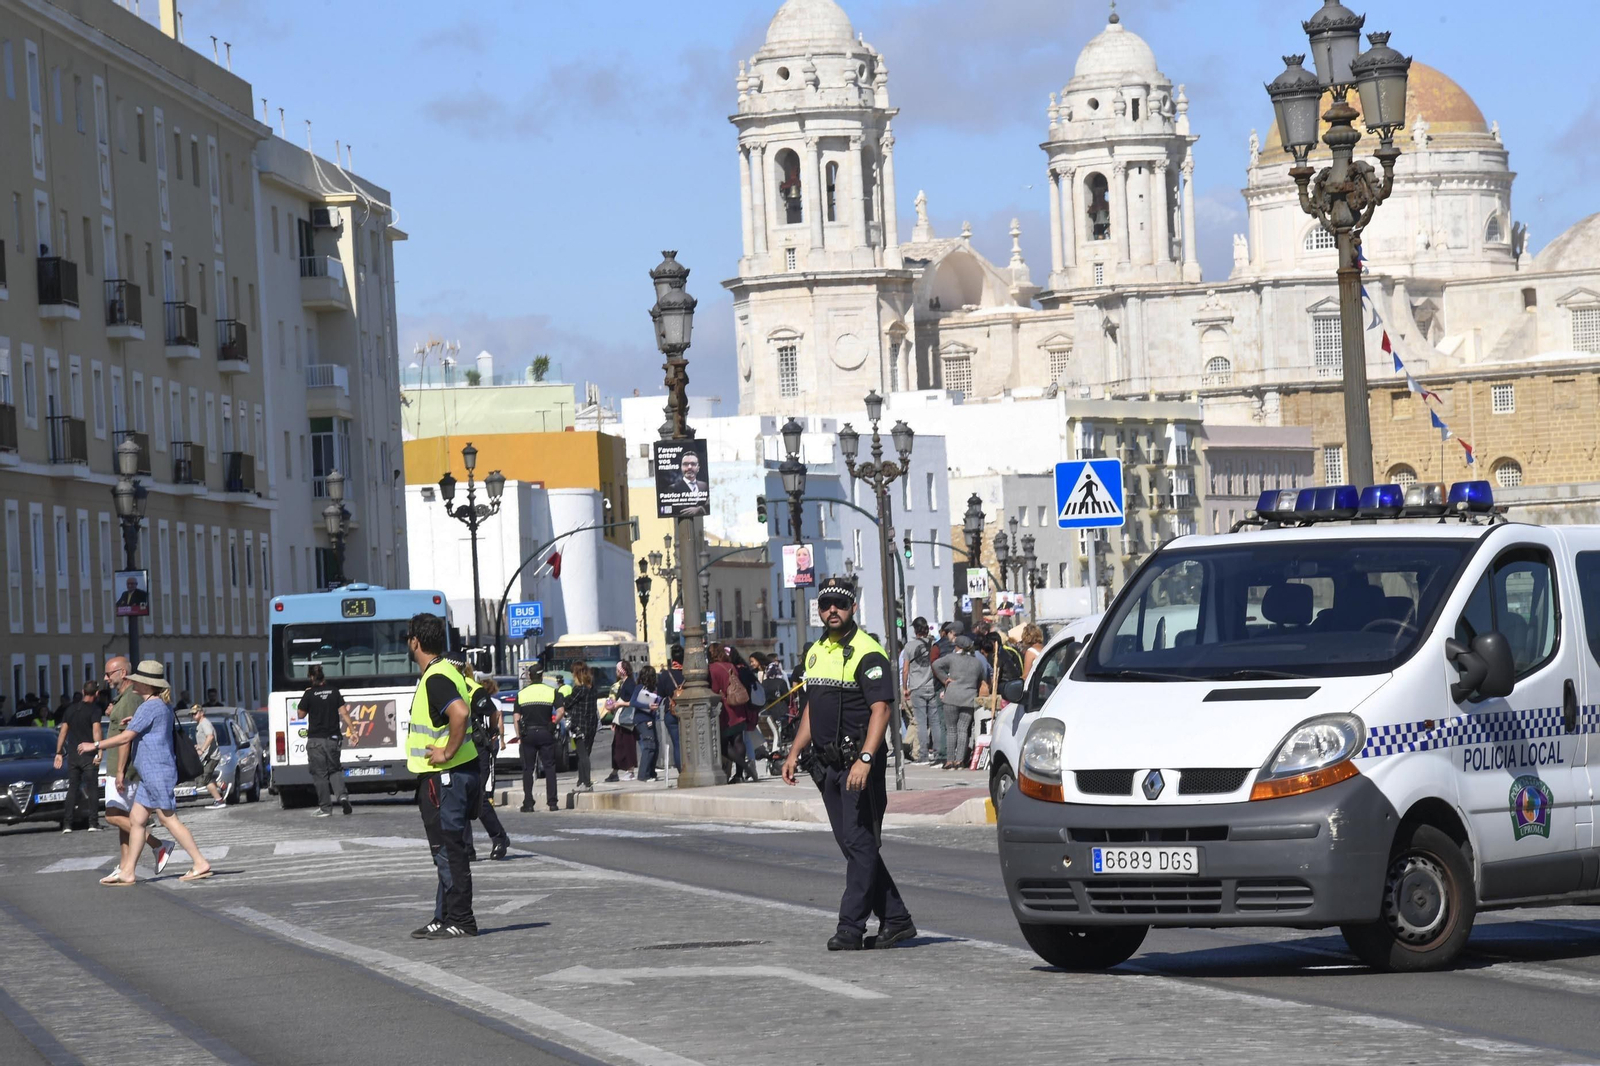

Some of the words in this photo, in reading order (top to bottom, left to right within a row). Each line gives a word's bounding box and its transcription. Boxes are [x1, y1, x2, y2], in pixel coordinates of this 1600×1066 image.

[346, 600, 369, 616] 31
[515, 607, 535, 616] BUS
[1463, 745, 1516, 772] POLICIA
[1520, 741, 1564, 767] LOCAL
[1105, 851, 1152, 869] 6689
[1159, 851, 1192, 870] DGS
